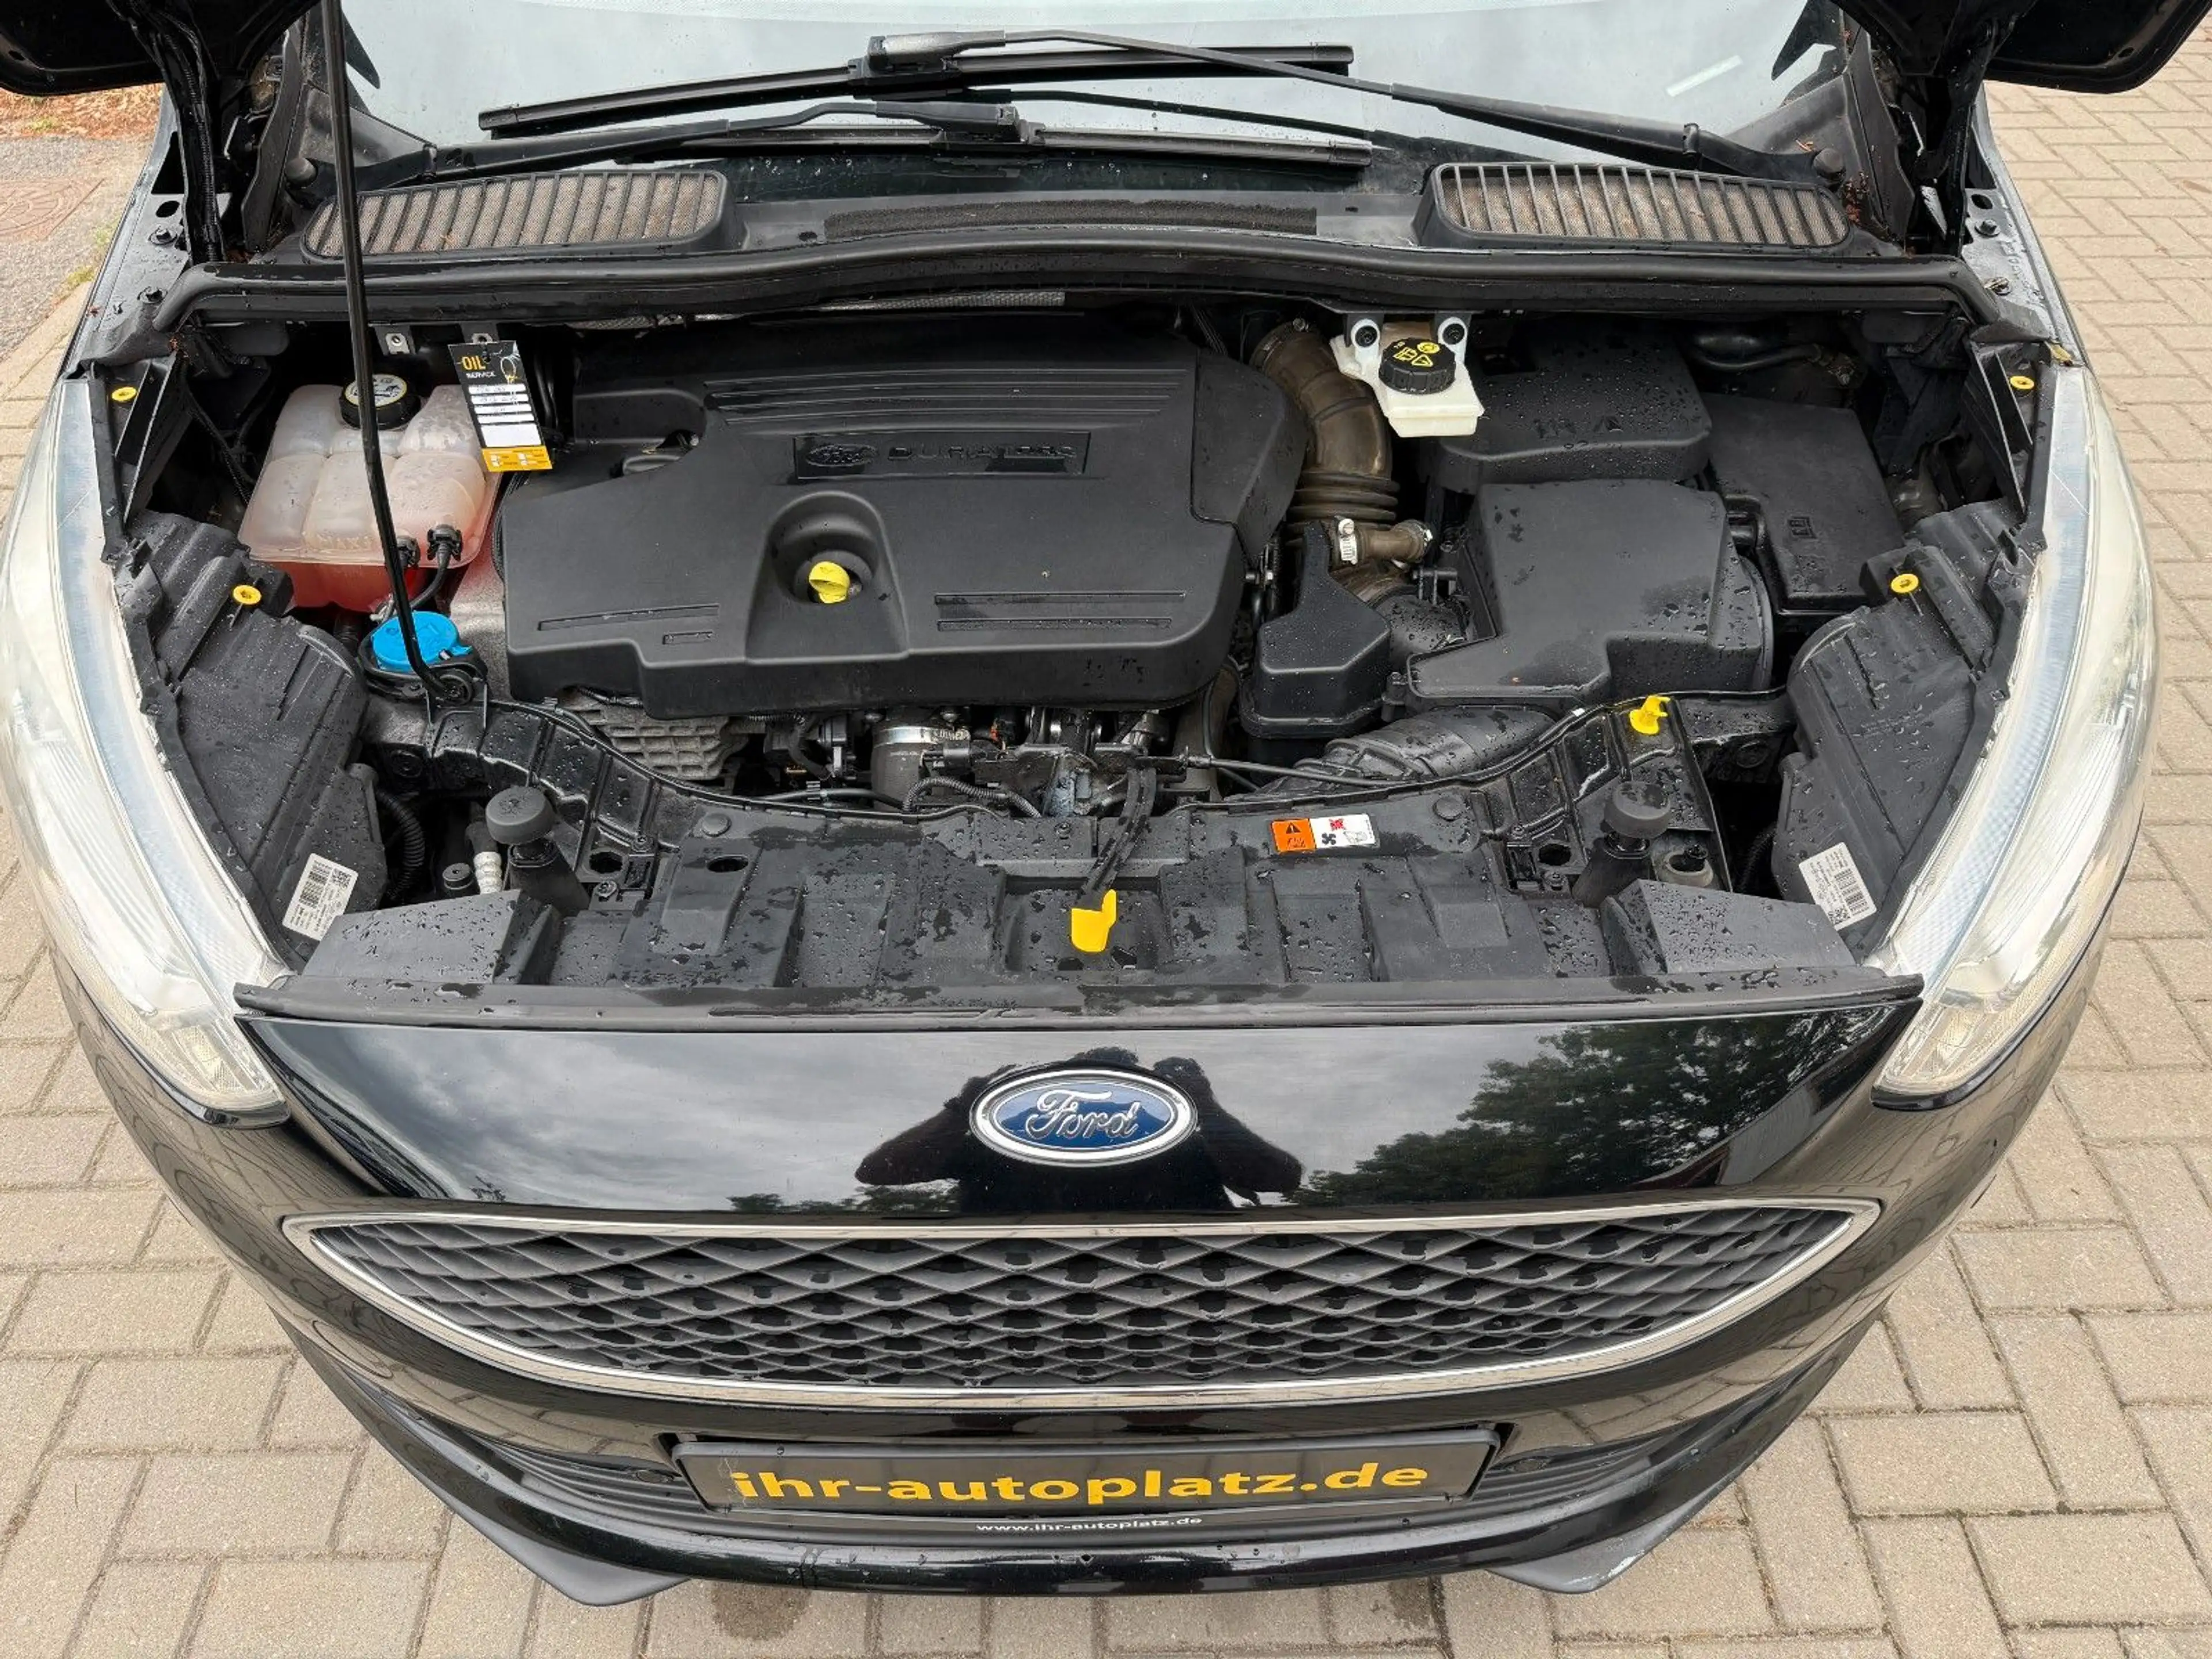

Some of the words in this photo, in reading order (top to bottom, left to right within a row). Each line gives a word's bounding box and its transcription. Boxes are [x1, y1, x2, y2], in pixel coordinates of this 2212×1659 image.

[462, 355, 486, 370] OIL
[1025, 1089, 1141, 1139] Ford
[731, 1462, 1427, 1505] ihr-autoplatz.de
[976, 1517, 1203, 1531] www.ihr-autoplatz.de
